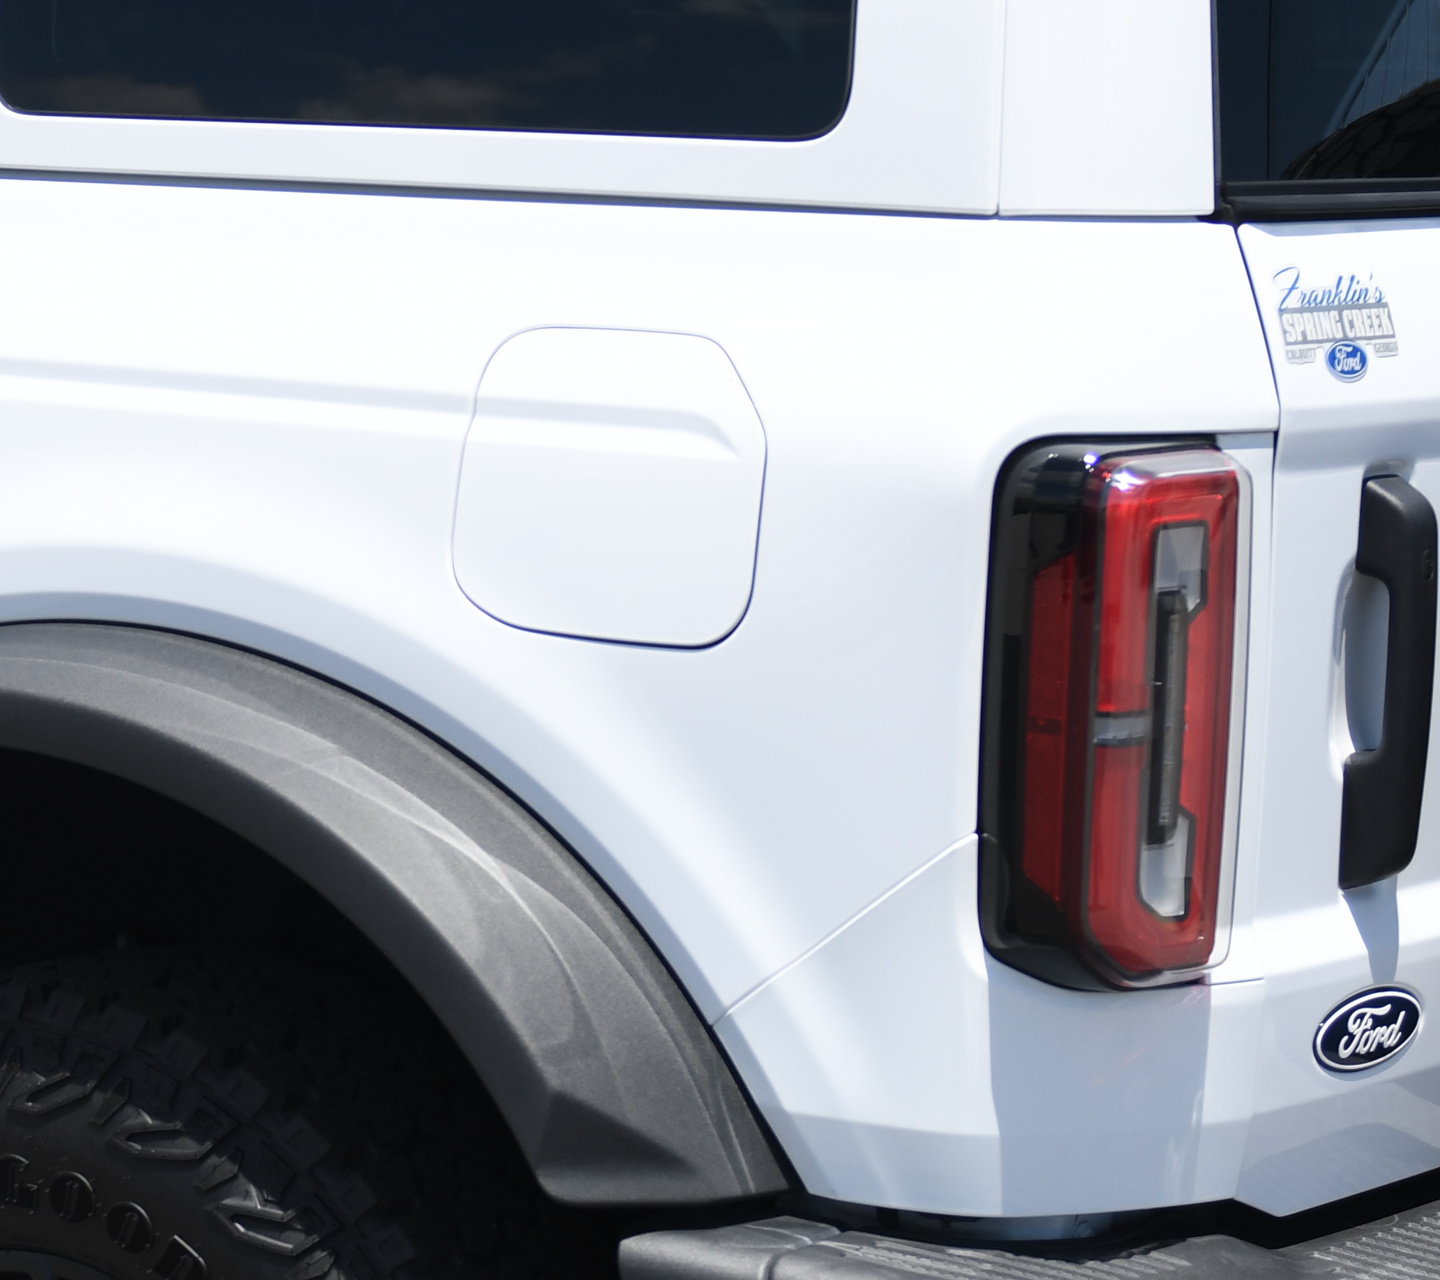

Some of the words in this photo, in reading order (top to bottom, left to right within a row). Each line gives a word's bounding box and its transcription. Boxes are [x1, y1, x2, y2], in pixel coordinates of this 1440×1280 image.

[1273, 266, 1385, 312] Franklin's
[1282, 310, 1344, 342] SPRING
[1342, 307, 1394, 338] CREEK
[1334, 346, 1362, 371] Ford
[1338, 1004, 1406, 1059] Ford
